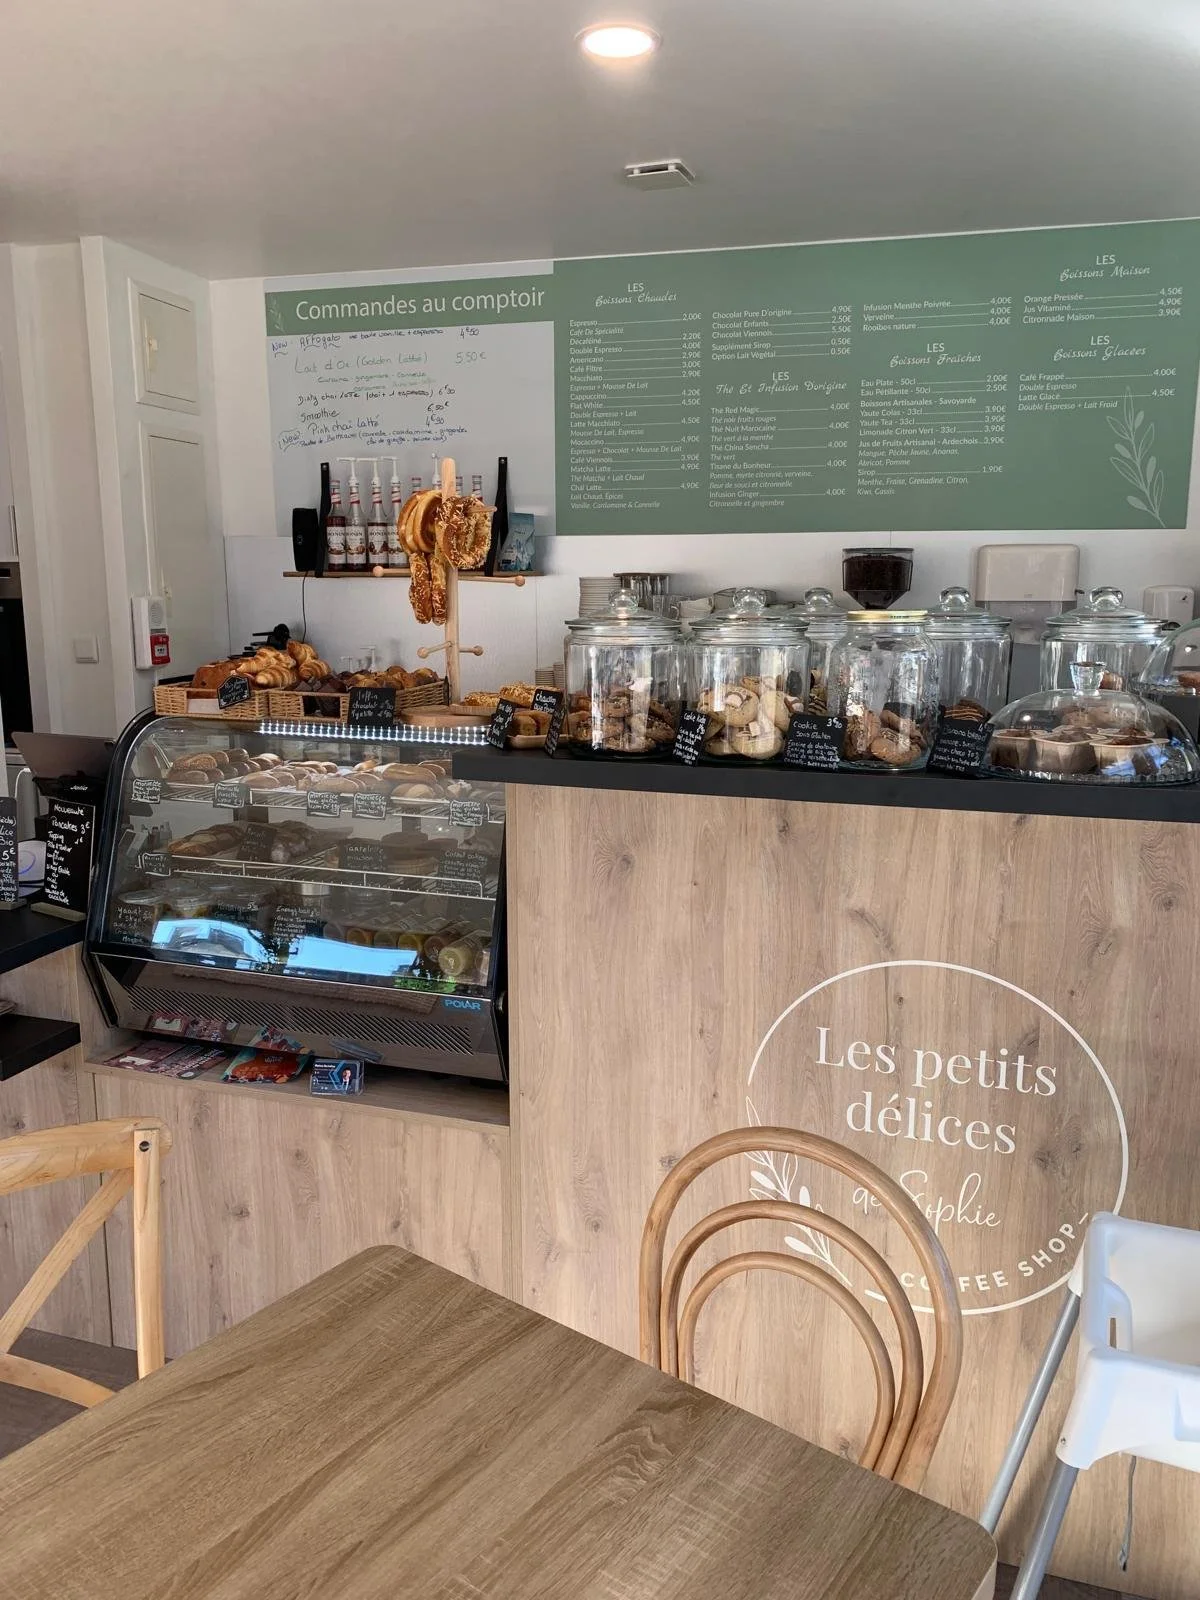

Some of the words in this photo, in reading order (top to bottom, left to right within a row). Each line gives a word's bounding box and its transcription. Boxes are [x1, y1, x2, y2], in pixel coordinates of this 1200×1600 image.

[1096, 255, 1115, 265] LES
[1060, 269, 1104, 282] Boissons
[1111, 266, 1150, 277] Maison
[628, 283, 644, 292] LES
[296, 295, 417, 321] Commandes
[422, 297, 445, 312] au
[452, 287, 545, 314] comptoir
[596, 296, 633, 307] Boissons
[638, 291, 677, 303] Chaudes
[1024, 296, 1051, 304] Orange
[570, 320, 598, 328] Espresso
[1023, 315, 1064, 324] Citronnade
[1091, 336, 1110, 346] LES
[595, 346, 623, 355] Espresso
[927, 343, 945, 353] LES
[1054, 349, 1097, 361] Boissons
[890, 355, 931, 368] Boissons
[773, 372, 790, 381] LES
[1046, 383, 1077, 391] Espresso
[571, 394, 607, 402] Cappuccino
[861, 400, 891, 408] Boissons
[1018, 403, 1043, 411] Double
[815, 1026, 896, 1074] Les
[912, 1048, 1057, 1097] petits
[846, 1091, 1017, 1155] délices
[900, 1170, 1001, 1236] Sophie
[1018, 1223, 1076, 1277] SHOP
